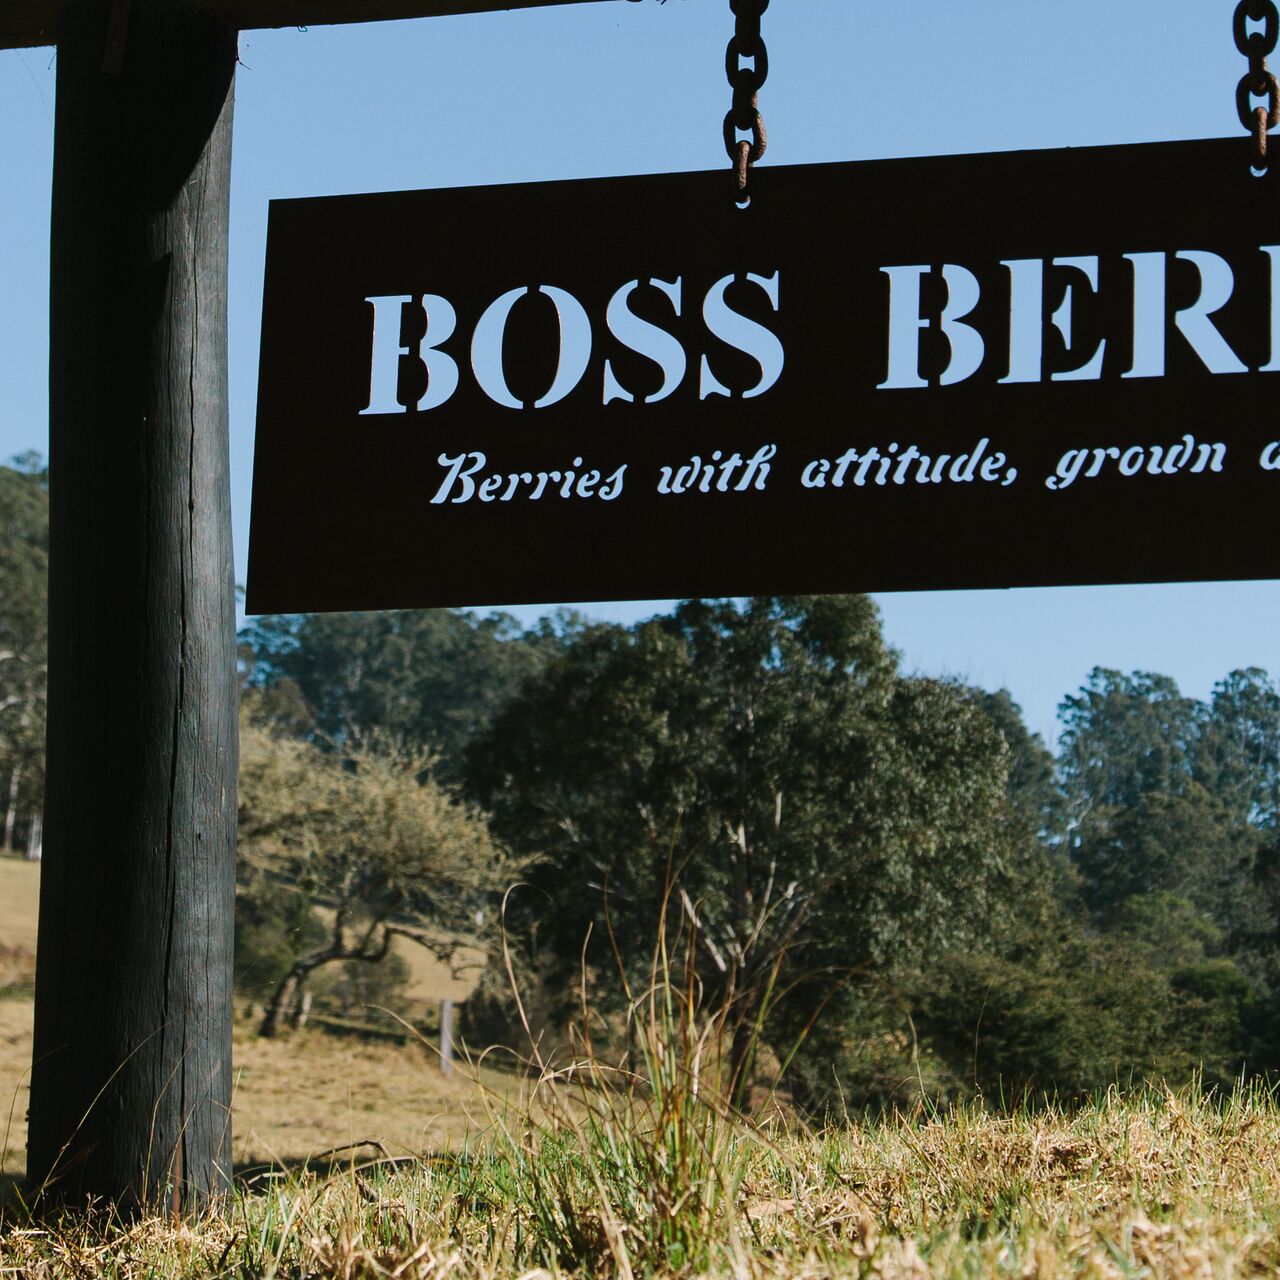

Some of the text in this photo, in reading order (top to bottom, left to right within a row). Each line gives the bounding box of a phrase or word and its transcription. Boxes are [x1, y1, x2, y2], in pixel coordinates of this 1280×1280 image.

[359, 270, 785, 415] BOSS
[429, 451, 628, 505] Berries
[656, 443, 777, 495] with
[800, 437, 1019, 489] attitude,
[1045, 433, 1227, 490] grown
